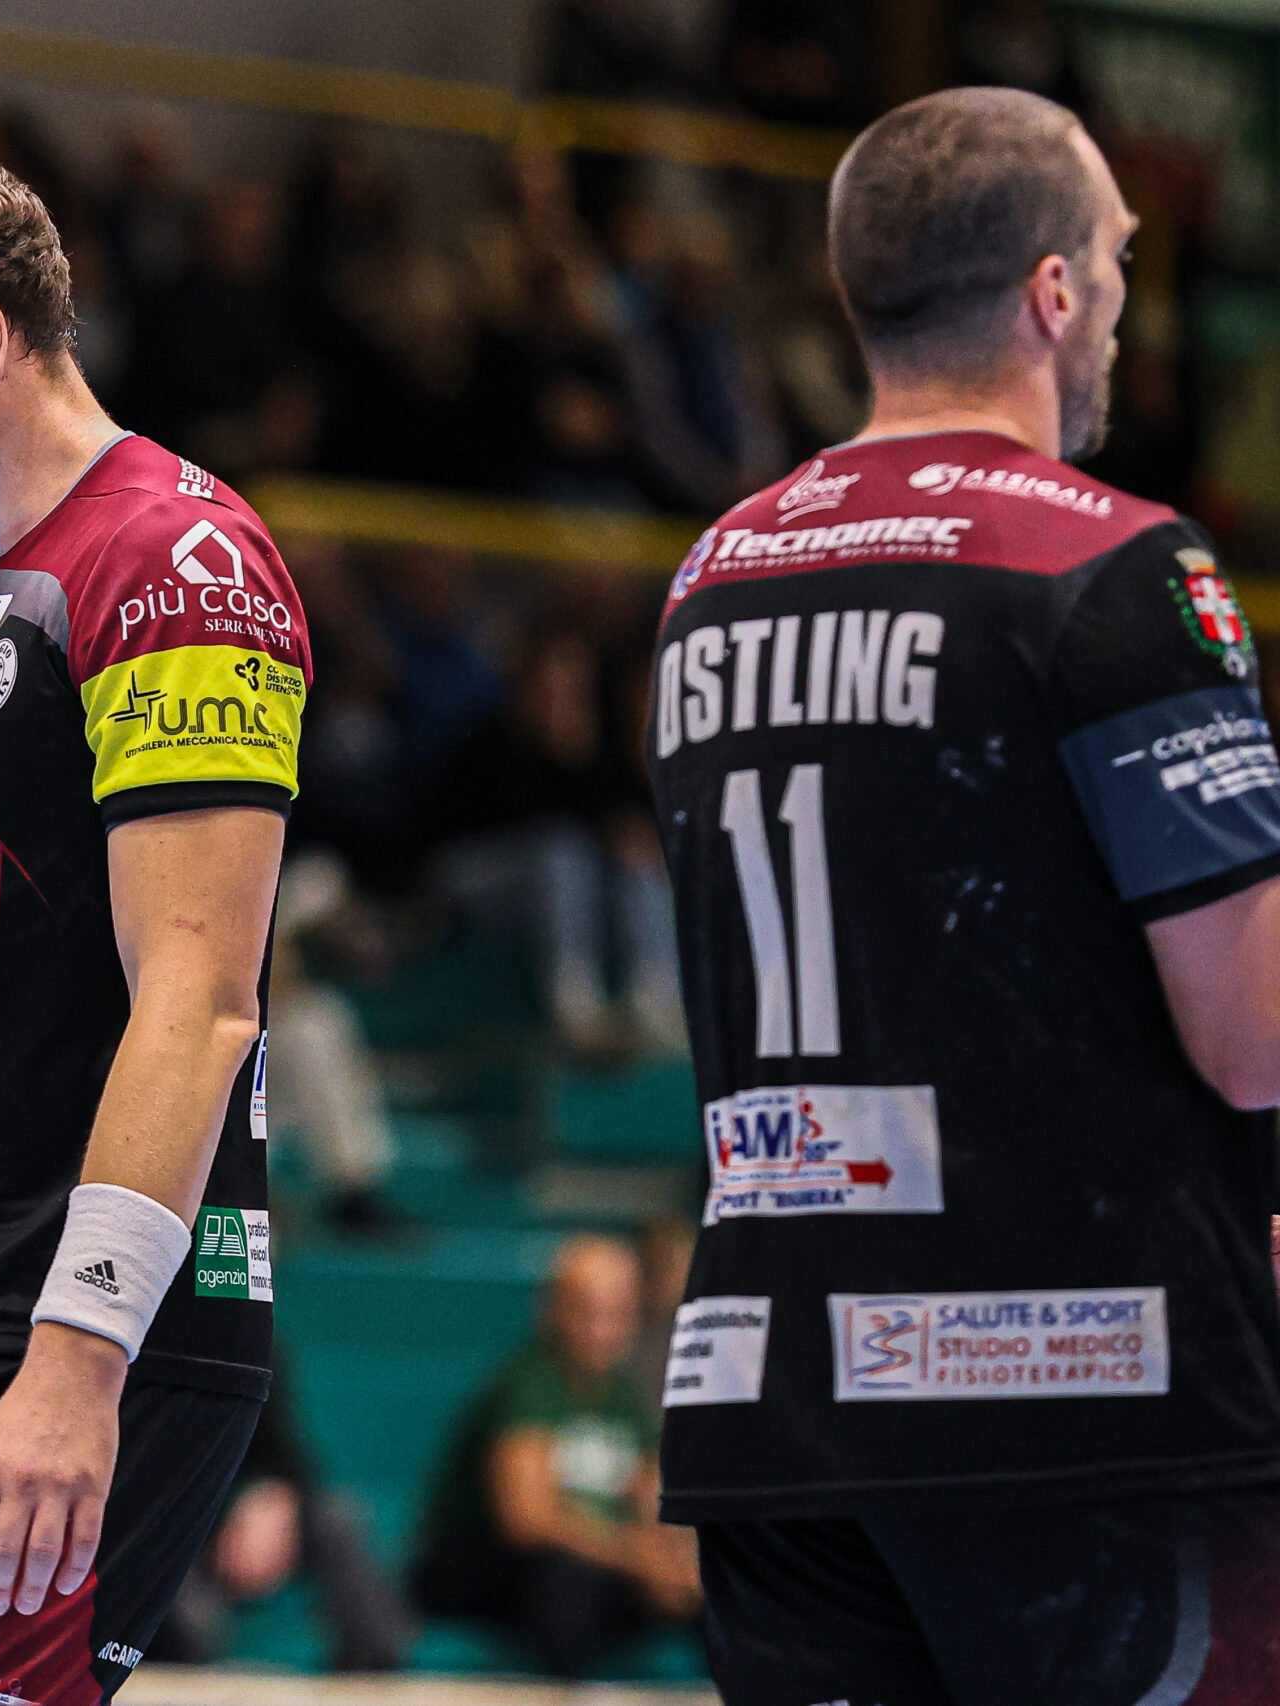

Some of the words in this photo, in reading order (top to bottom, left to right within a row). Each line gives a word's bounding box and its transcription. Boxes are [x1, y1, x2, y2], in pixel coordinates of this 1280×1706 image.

[119, 578, 186, 641] più
[199, 586, 292, 632] casa
[657, 609, 945, 759] OSTLING
[176, 735, 239, 747] MECCANICA
[720, 763, 841, 1058] 11
[75, 1266, 120, 1295] adidas
[198, 1268, 247, 1288] agenzia
[939, 1303, 1033, 1329] SALUTE
[1064, 1300, 1144, 1326] SPORT
[937, 1336, 1033, 1360] STUDIO
[1045, 1333, 1144, 1357] MEDICO
[937, 1361, 1144, 1386] FISIOTERAPICO
